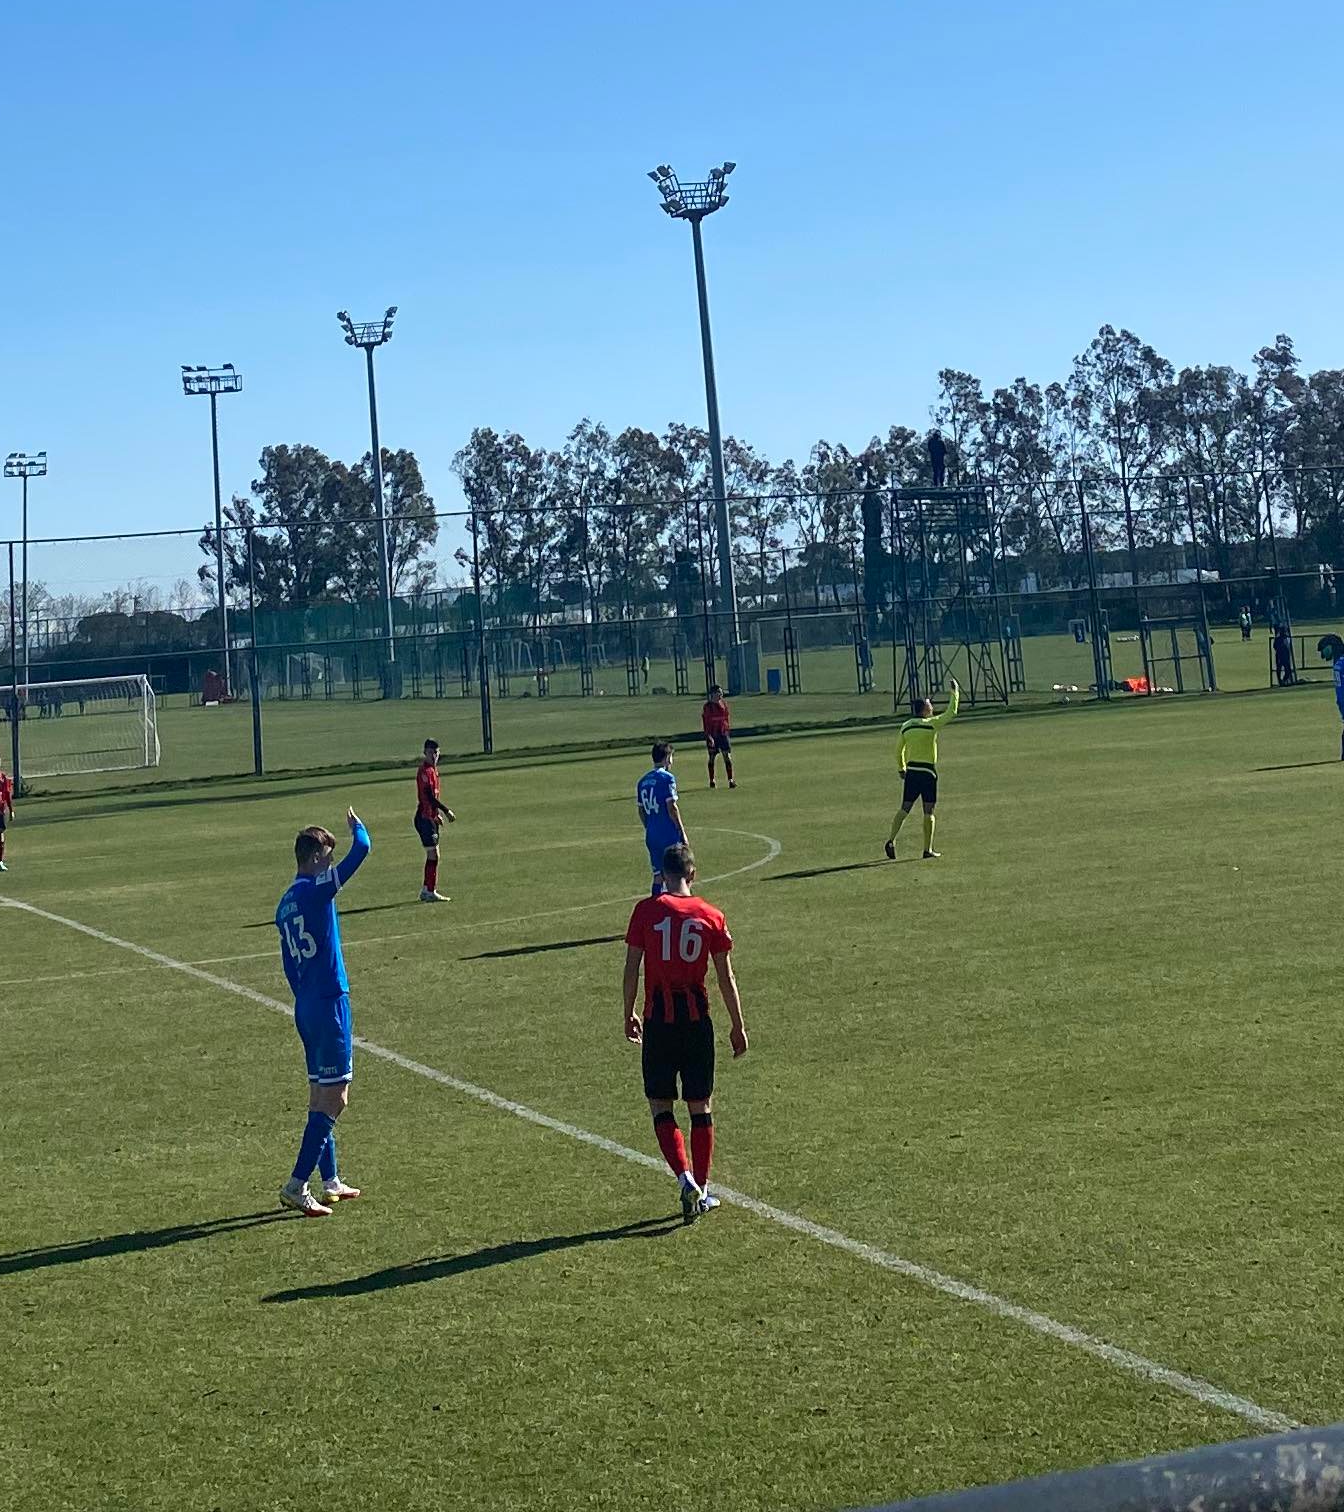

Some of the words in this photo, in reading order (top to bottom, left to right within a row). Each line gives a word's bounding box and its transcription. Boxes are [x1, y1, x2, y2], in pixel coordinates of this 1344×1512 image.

[641, 787, 659, 815] 64
[284, 915, 317, 963] 43
[654, 916, 703, 963] 16
